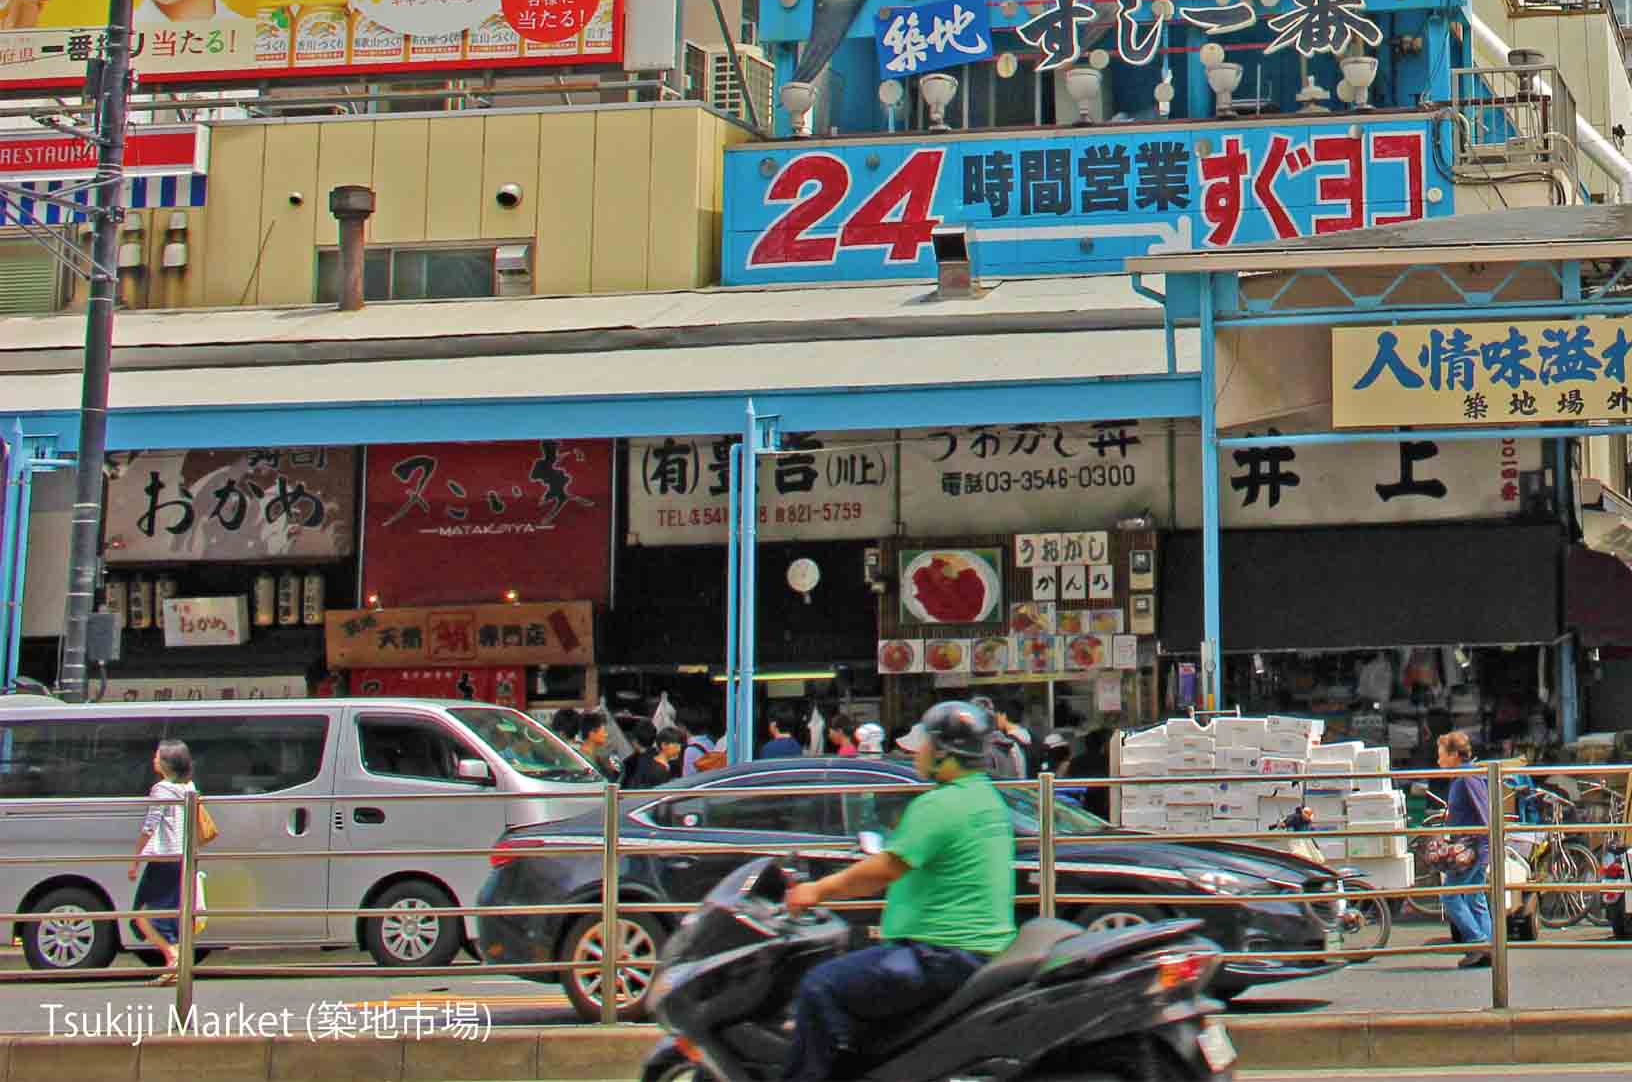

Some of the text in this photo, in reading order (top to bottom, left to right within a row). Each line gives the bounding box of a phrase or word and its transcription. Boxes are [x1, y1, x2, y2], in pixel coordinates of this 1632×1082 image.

[883, 5, 990, 72] 築地
[1198, 134, 1425, 249] すぐヨコ
